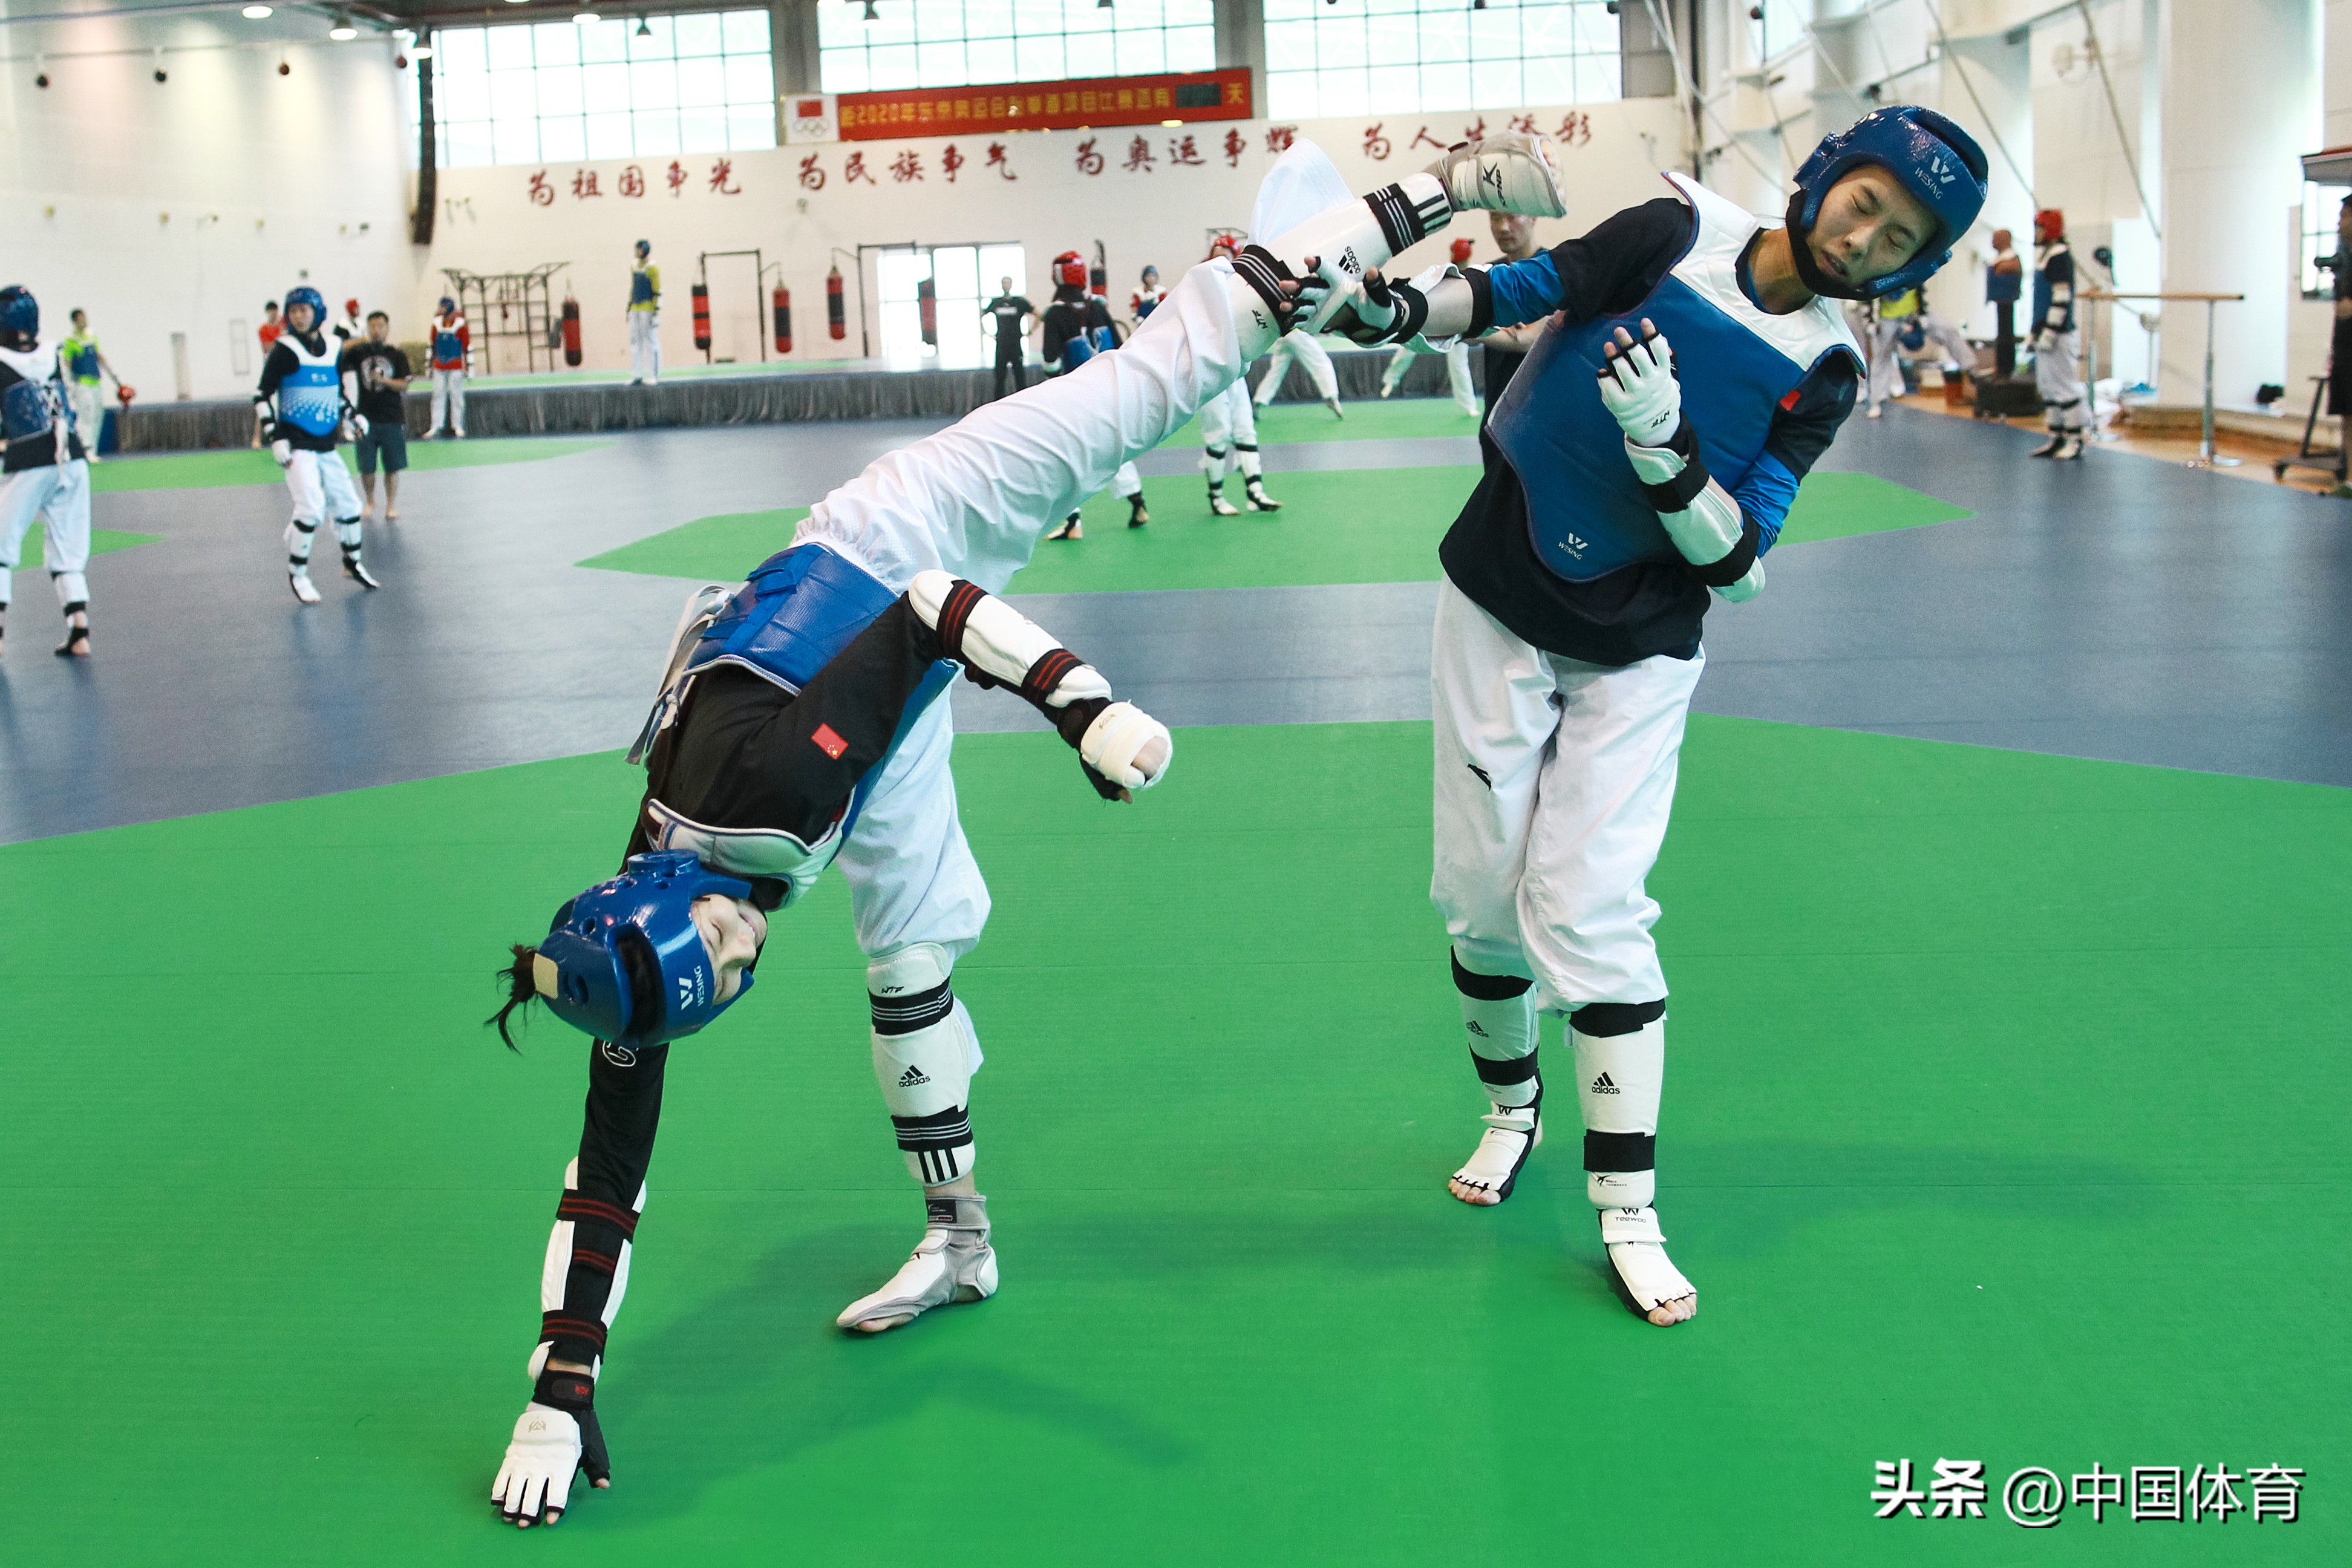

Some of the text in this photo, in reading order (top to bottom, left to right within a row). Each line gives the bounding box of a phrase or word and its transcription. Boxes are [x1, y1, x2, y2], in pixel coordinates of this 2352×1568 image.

[1228, 82, 1244, 105] 天
[528, 157, 742, 206] 为祖国争光
[799, 141, 1018, 191] 为民族争气
[1914, 166, 1944, 200] WESING
[1344, 245, 1361, 274] adidas
[1558, 541, 1583, 560] WESING
[694, 964, 705, 1007] WESING
[881, 985, 904, 995] WTF
[898, 1075, 931, 1088] adidas
[1591, 1085, 1621, 1094] adidas
